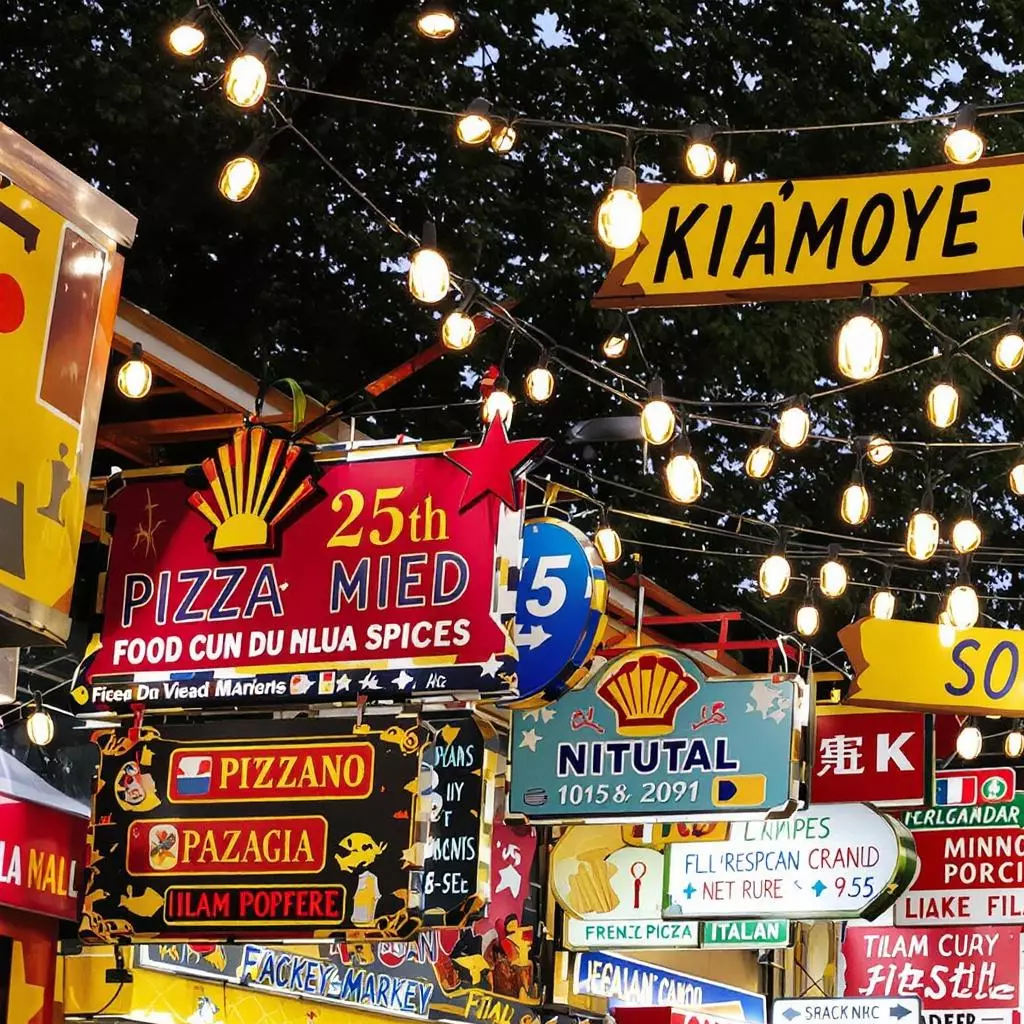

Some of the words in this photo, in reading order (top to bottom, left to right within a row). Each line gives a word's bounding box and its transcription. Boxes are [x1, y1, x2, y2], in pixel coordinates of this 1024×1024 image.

[327, 485, 449, 549] 25th
[120, 564, 285, 629] PIZZA
[329, 553, 470, 613] MIED
[113, 638, 182, 666] FOOD
[189, 632, 242, 660] CUN
[248, 630, 284, 657] DU
[365, 618, 471, 651] SPICES
[219, 753, 365, 790] PIZZANO
[557, 737, 740, 777] NITUTAL
[640, 780, 699, 804] 2091
[182, 829, 315, 863] PAZAGIA
[702, 881, 736, 901] NET
[742, 879, 784, 899] RURE
[904, 895, 971, 919] LIAKE
[709, 921, 779, 942] ITALAN
